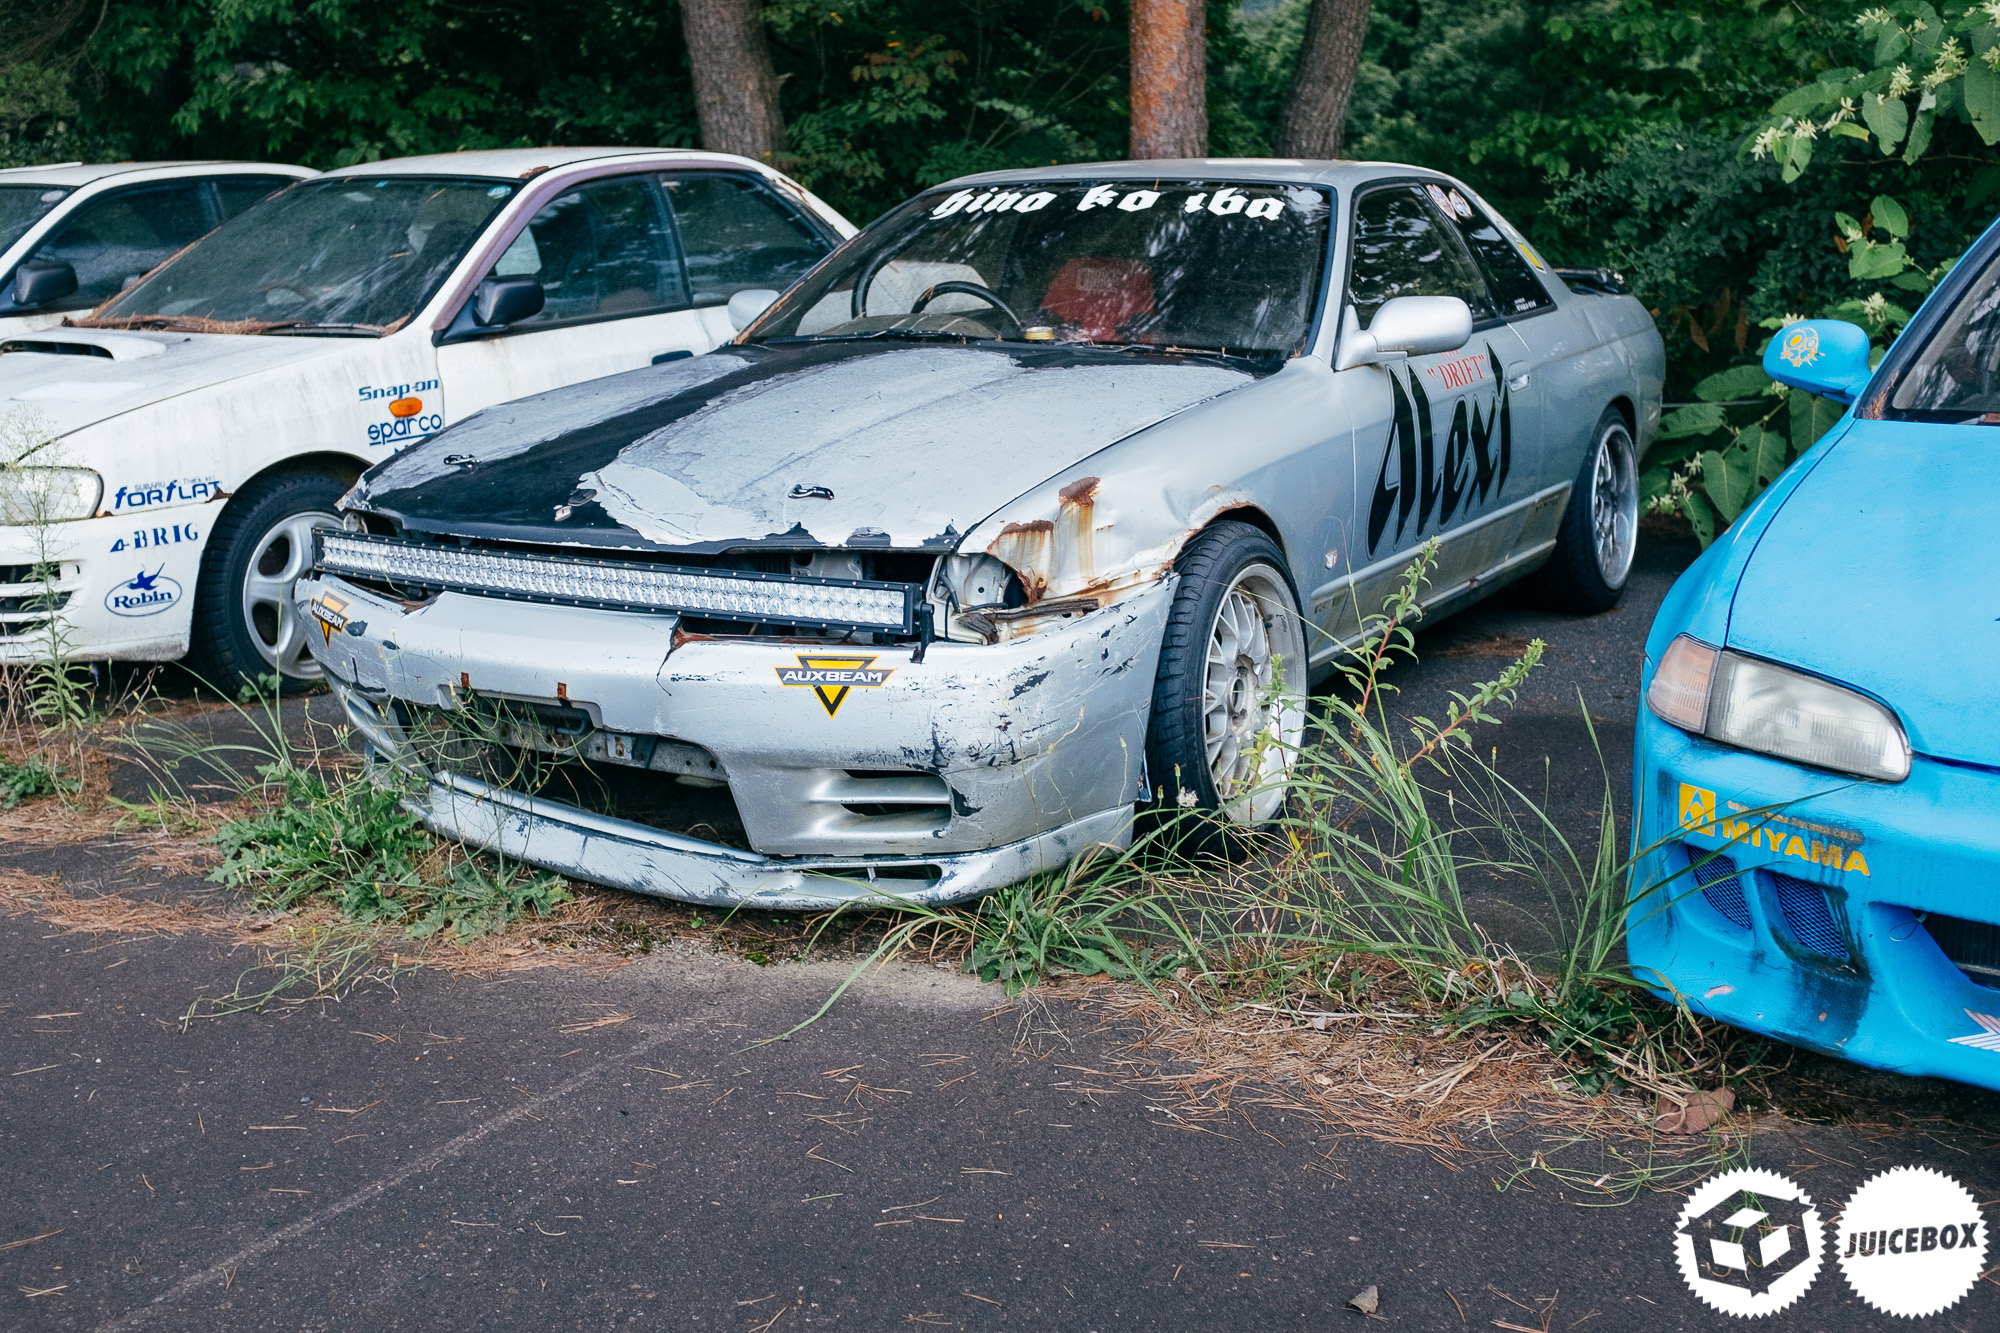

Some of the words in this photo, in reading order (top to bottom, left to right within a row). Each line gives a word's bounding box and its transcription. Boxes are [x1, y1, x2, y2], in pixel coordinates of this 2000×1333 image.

[1076, 184, 1161, 212] ko
[358, 379, 439, 401] Snap-on
[367, 414, 442, 445] sparco
[114, 591, 173, 608] Robin
[311, 602, 344, 629] AUXBEAM
[782, 670, 883, 683] AUXBEAM
[1723, 818, 1871, 877] MIYAMA
